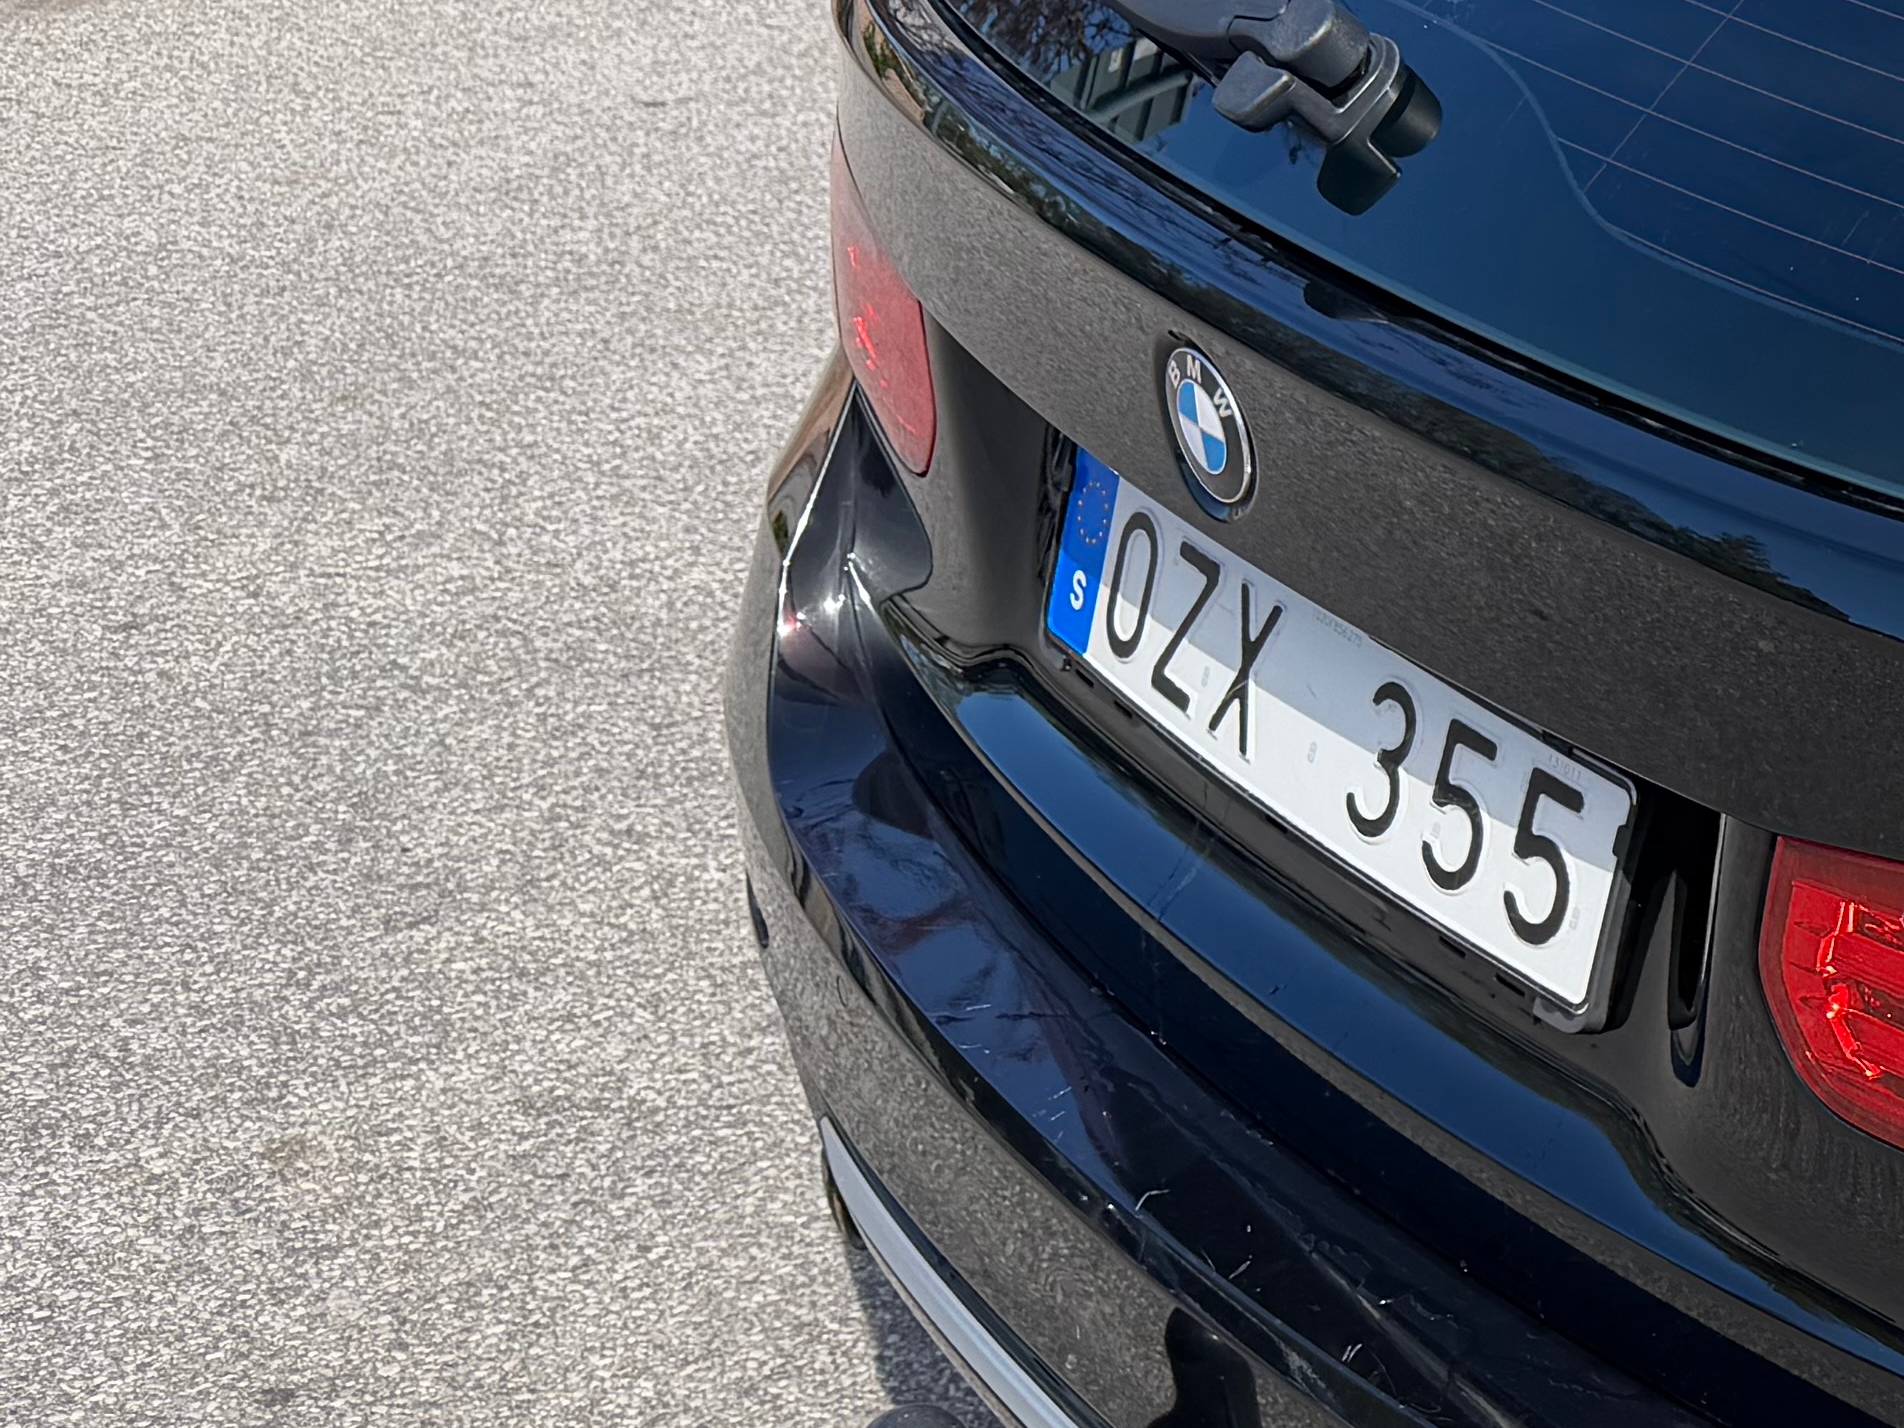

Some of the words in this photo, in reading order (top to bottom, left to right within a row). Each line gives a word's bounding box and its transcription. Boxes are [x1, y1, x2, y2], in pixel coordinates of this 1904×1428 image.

[1168, 355, 1233, 418] BMW
[1069, 569, 1087, 612] S
[1105, 510, 1284, 762] OZX
[1345, 680, 1585, 947] 355
